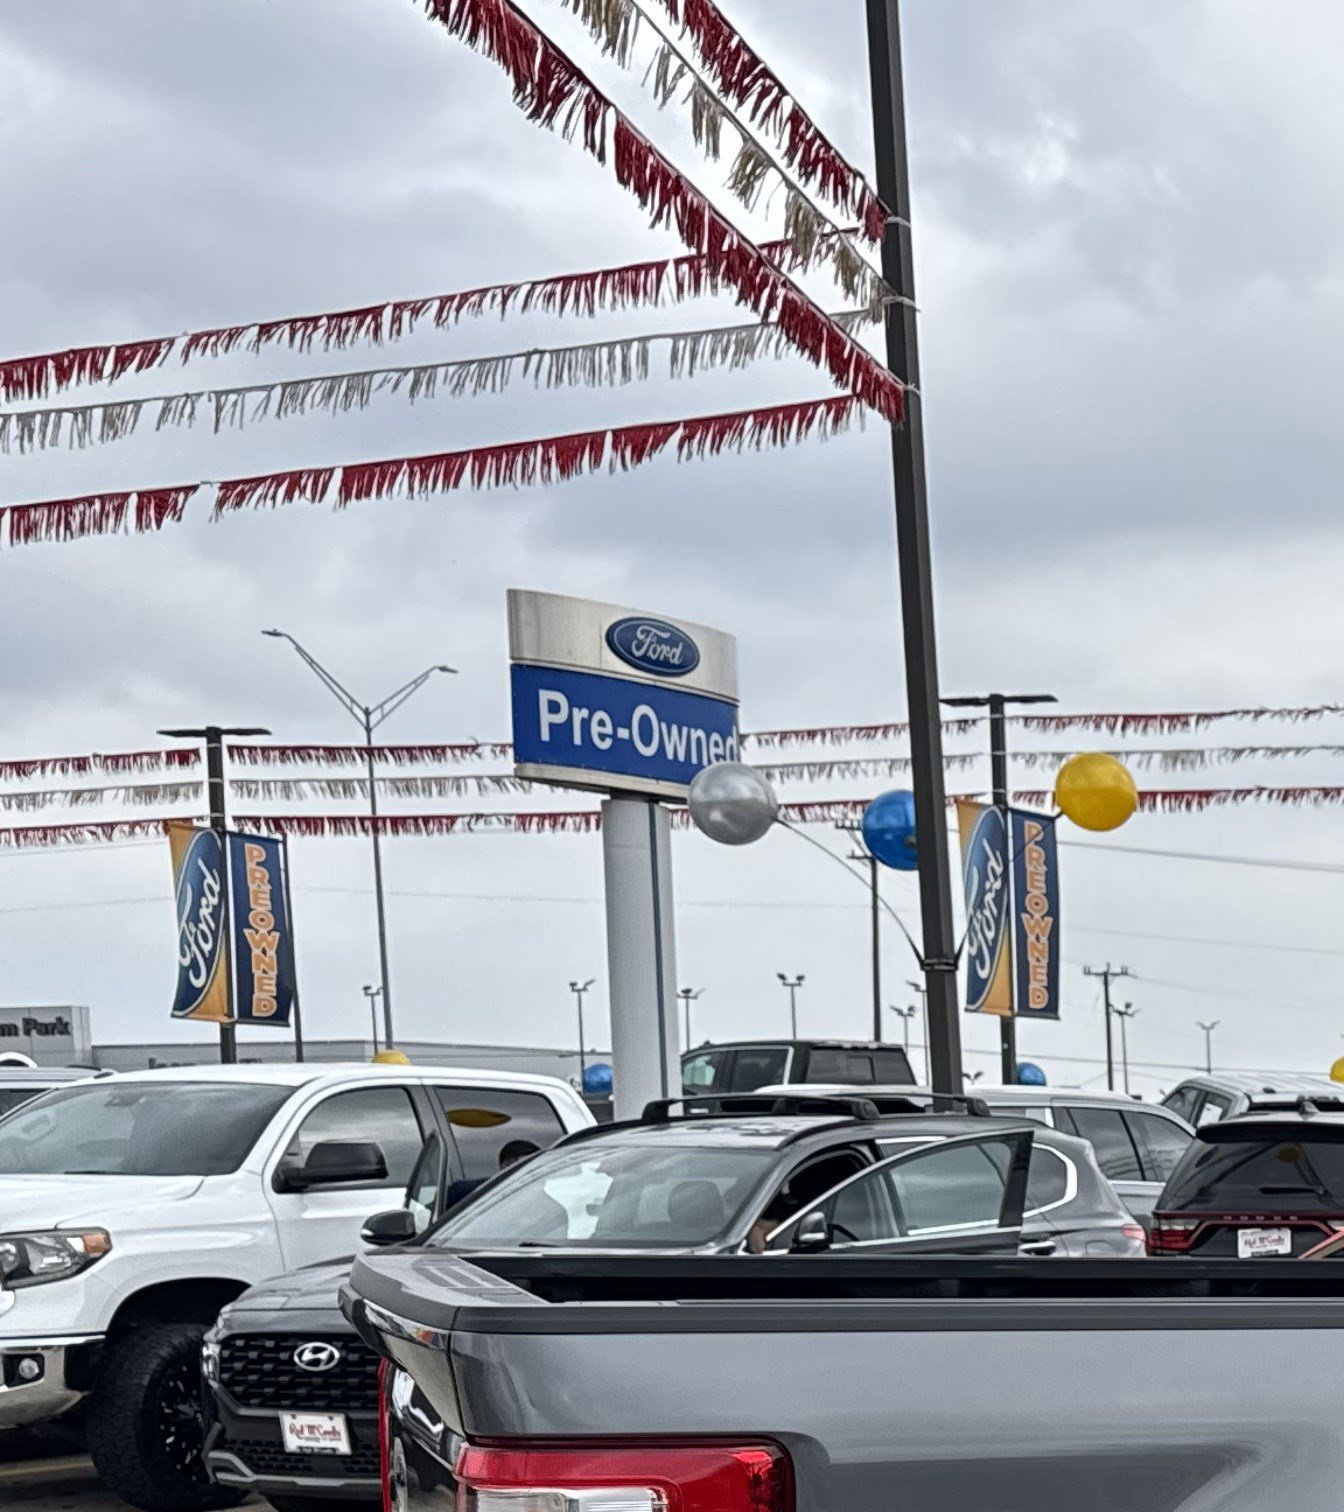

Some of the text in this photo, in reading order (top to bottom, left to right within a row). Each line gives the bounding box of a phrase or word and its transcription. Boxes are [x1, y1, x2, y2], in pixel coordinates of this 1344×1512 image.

[631, 624, 683, 666] Ford
[538, 688, 738, 766] Pre-Owned
[179, 856, 220, 989] Ford
[243, 842, 280, 1018] PREOWNED
[966, 837, 1004, 980] Ford
[1021, 820, 1054, 1009] PREOWNED
[22, 1016, 71, 1037] Park
